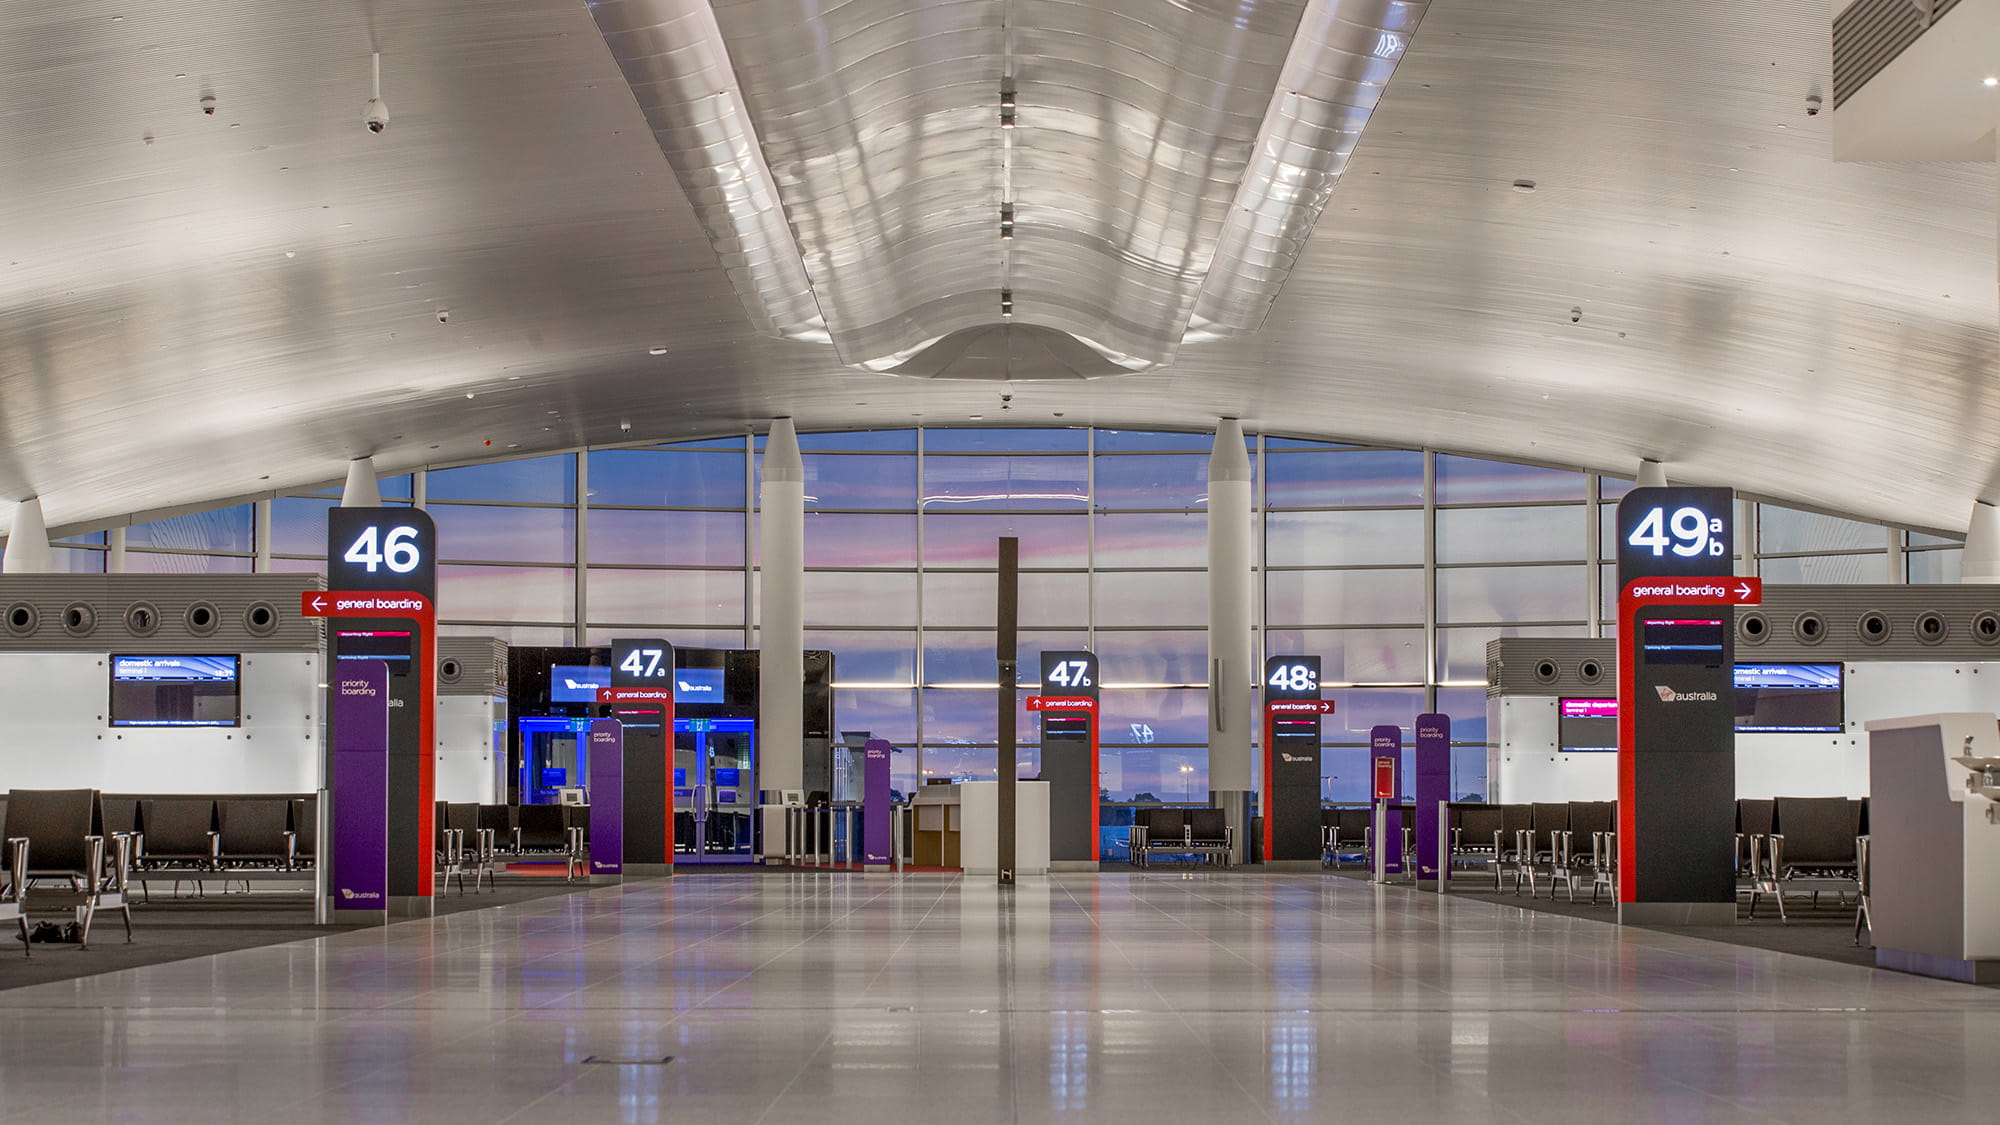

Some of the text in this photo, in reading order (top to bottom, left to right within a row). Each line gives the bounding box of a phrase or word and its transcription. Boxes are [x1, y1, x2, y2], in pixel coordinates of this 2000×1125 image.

[1628, 506, 1709, 557] 49
[344, 526, 420, 573] 46
[1633, 584, 1725, 597] general boarding
[336, 598, 422, 610] general boarding
[120, 659, 181, 667] domestic arrivals
[1268, 665, 1308, 691] 48
[342, 680, 369, 689] priority
[342, 688, 376, 696] boarding
[1676, 691, 1717, 700] australia
